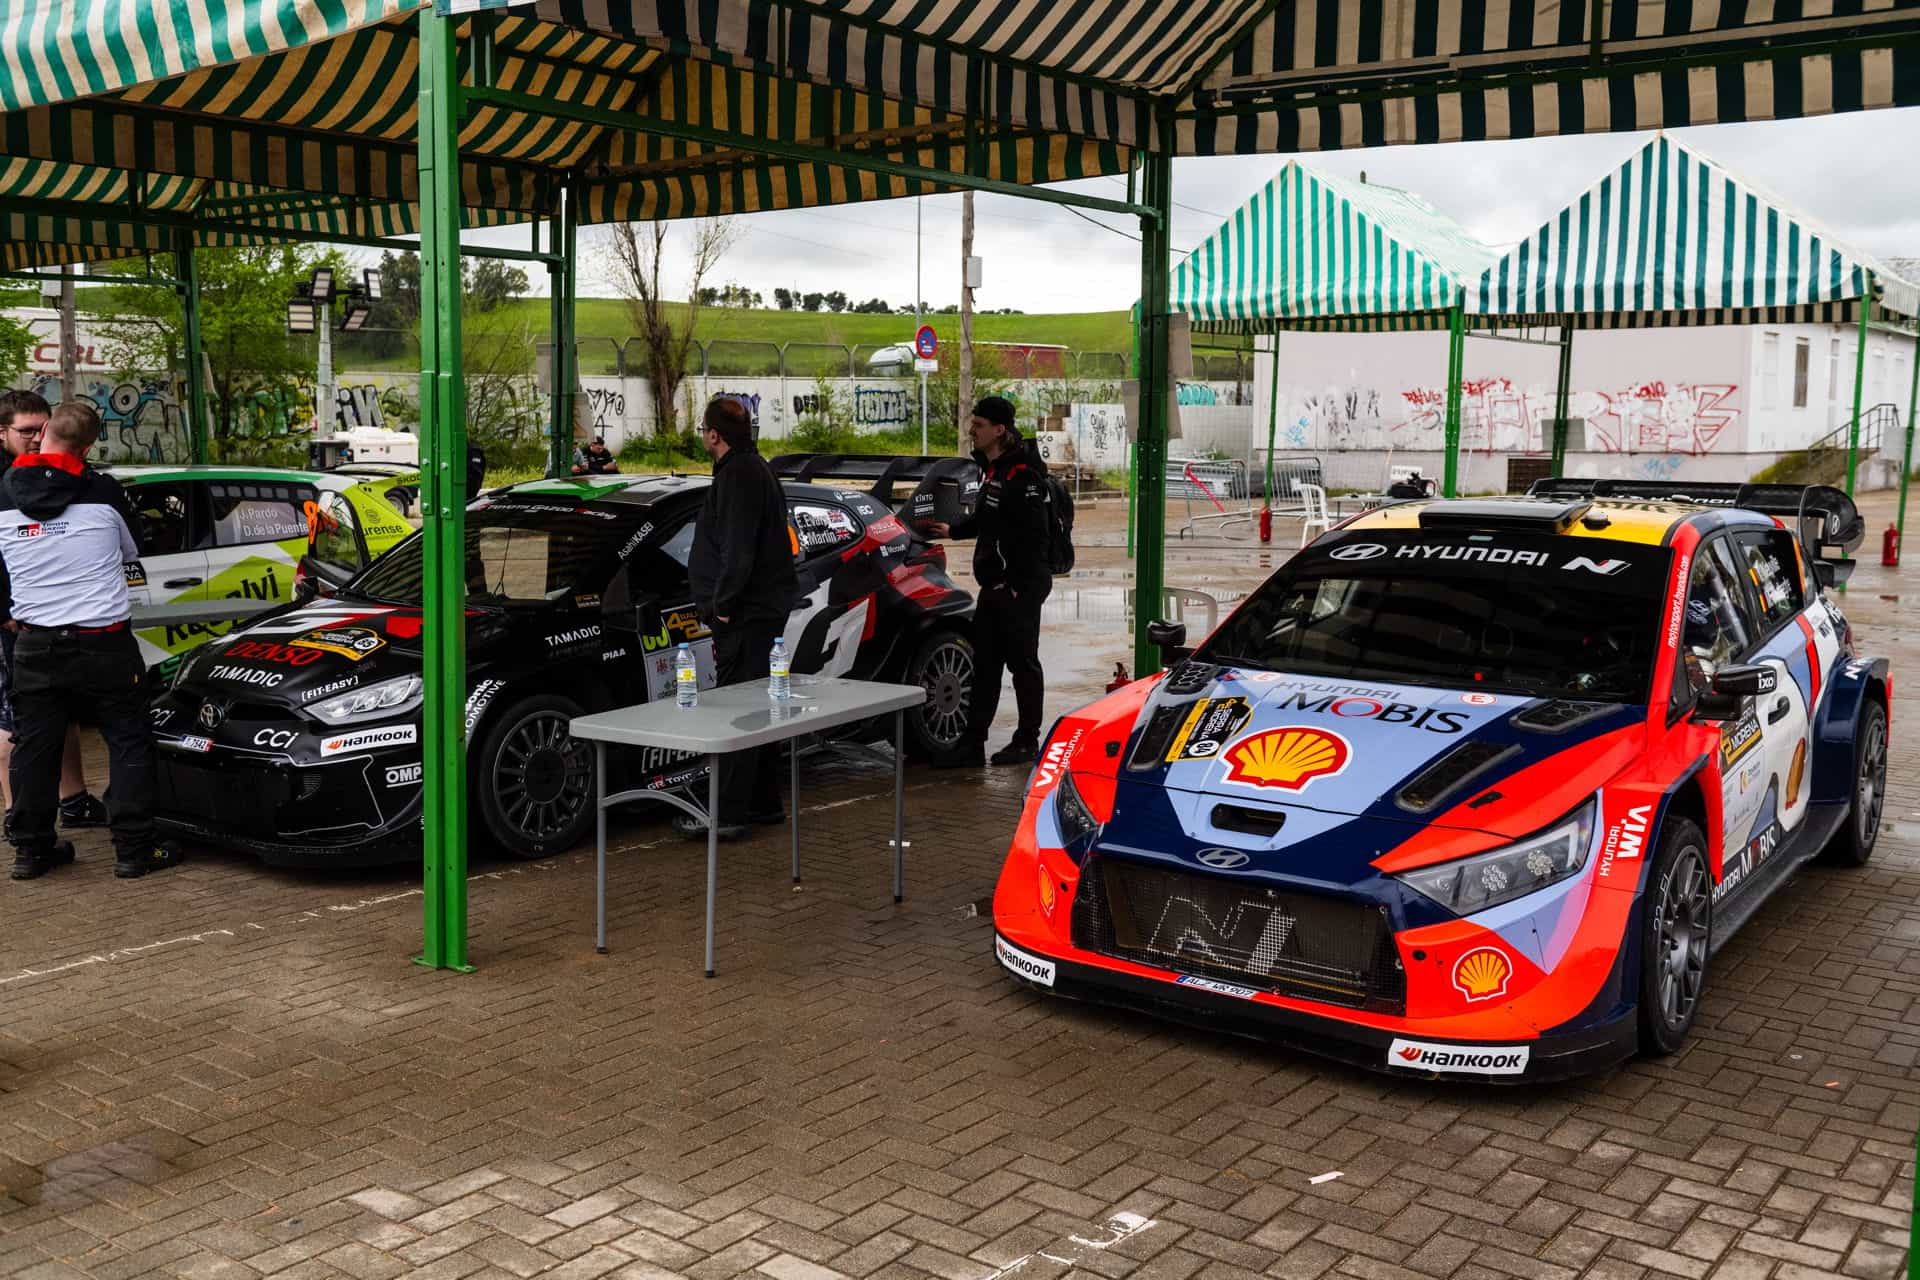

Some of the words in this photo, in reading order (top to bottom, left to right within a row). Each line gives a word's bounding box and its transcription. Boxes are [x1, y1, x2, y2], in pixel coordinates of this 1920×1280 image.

[19, 529, 39, 537] GR
[1395, 545, 1551, 567] HYUNDAI
[545, 625, 600, 647] TAMADIC
[224, 641, 322, 665] DENSO
[602, 648, 626, 662] PIAA
[208, 665, 284, 688] TAMADIC
[1275, 680, 1401, 700] HYUNDAI
[1278, 693, 1471, 734] MOBIS
[1060, 728, 1084, 769] HYUNDAI
[385, 765, 422, 784] OMP
[1617, 805, 1652, 858] WIA
[1600, 826, 1621, 877] HYUNDAI
[1711, 865, 1741, 905] HYUNDAI
